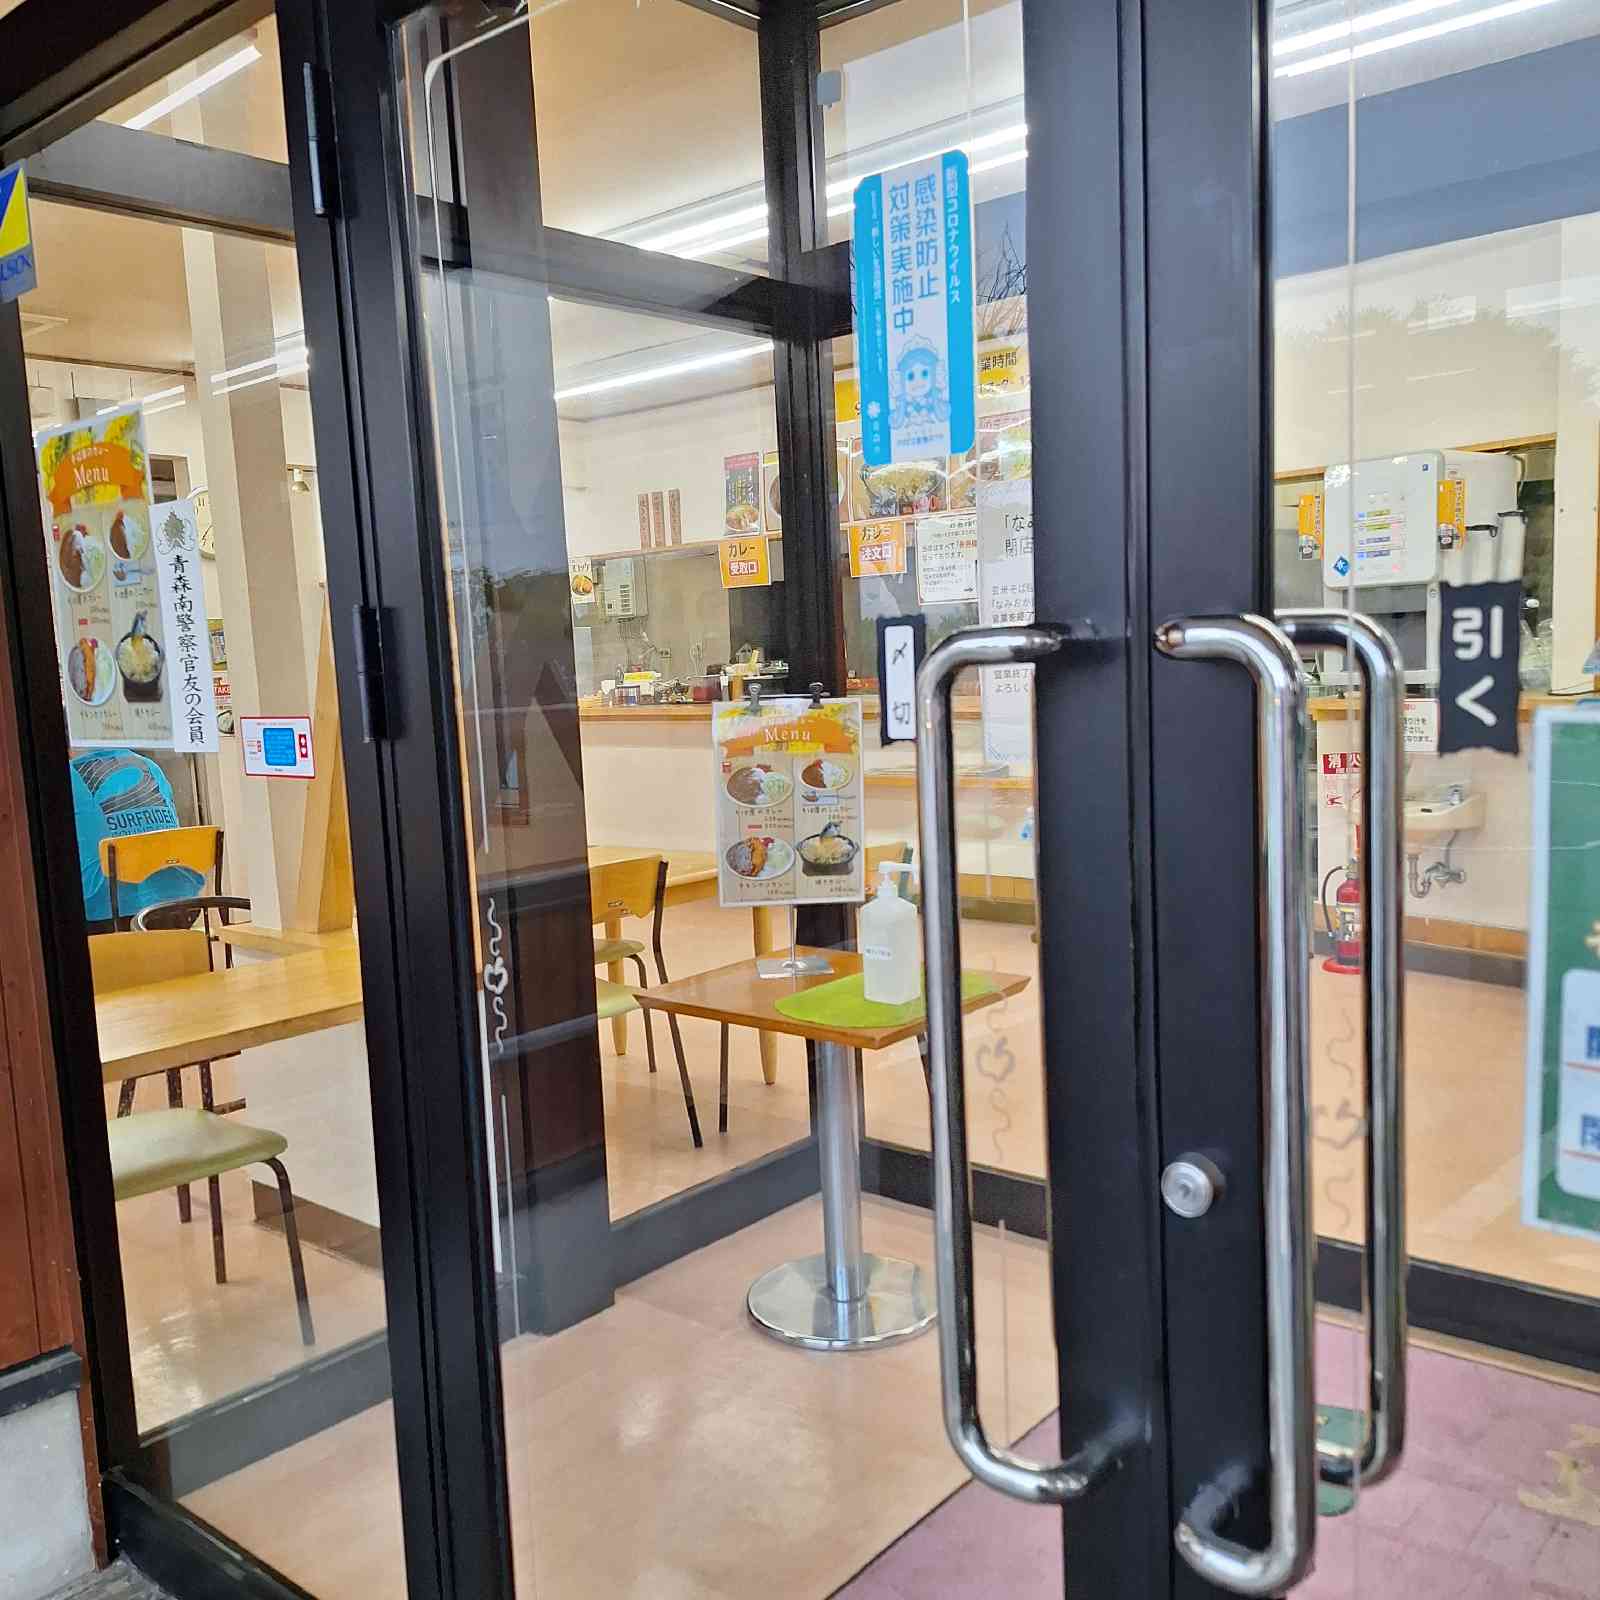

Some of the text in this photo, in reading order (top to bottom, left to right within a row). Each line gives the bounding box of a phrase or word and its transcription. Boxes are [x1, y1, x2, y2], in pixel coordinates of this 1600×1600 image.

[888, 182, 914, 335] 対策実施中
[914, 173, 940, 299] 感染防止
[74, 464, 110, 489] Menu
[728, 543, 756, 558] カレー
[168, 554, 205, 745] 青森南警察官友の会員
[1452, 605, 1503, 727] 引く
[764, 728, 811, 742] Menu
